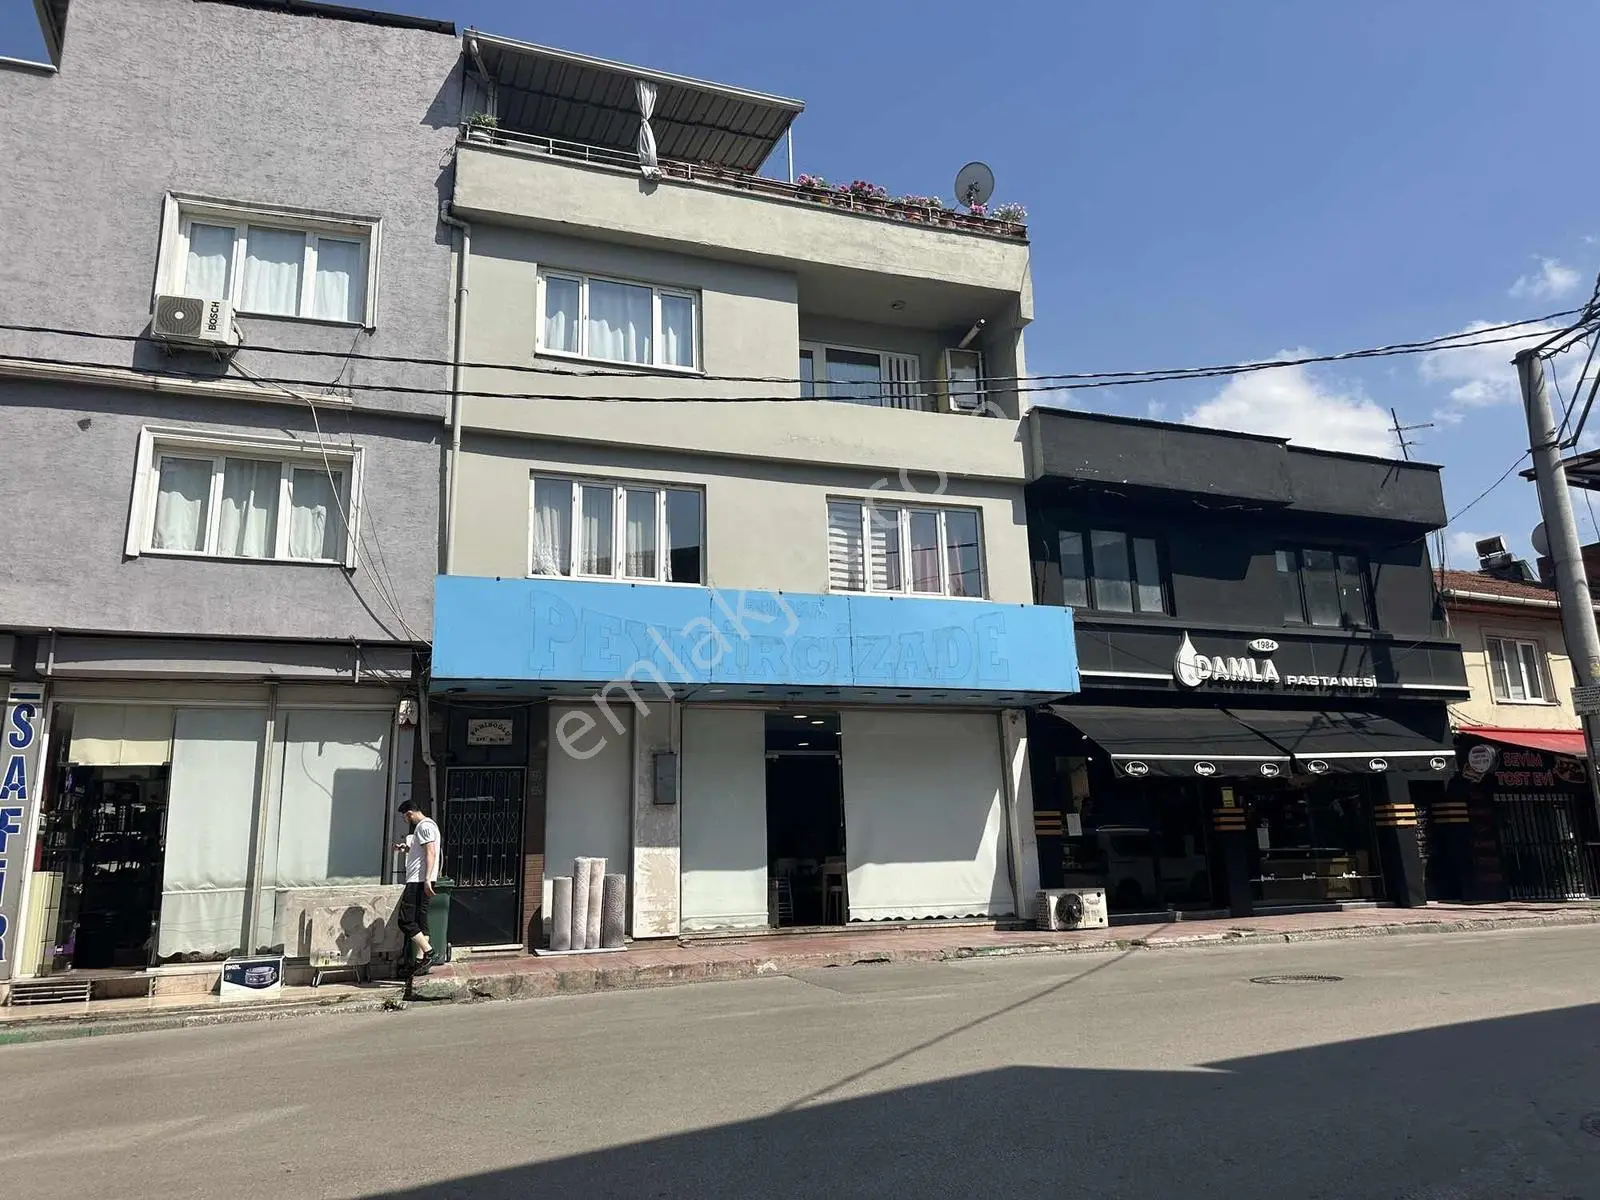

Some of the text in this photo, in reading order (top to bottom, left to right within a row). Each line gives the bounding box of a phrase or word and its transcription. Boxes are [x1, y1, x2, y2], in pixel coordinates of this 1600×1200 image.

[208, 301, 220, 331] BOSCH
[1255, 639, 1275, 650] 1984
[1194, 655, 1378, 688] DAMLA PASTANESİ
[1503, 750, 1543, 767] SEVİM
[1495, 769, 1556, 786] TOST EVİ
